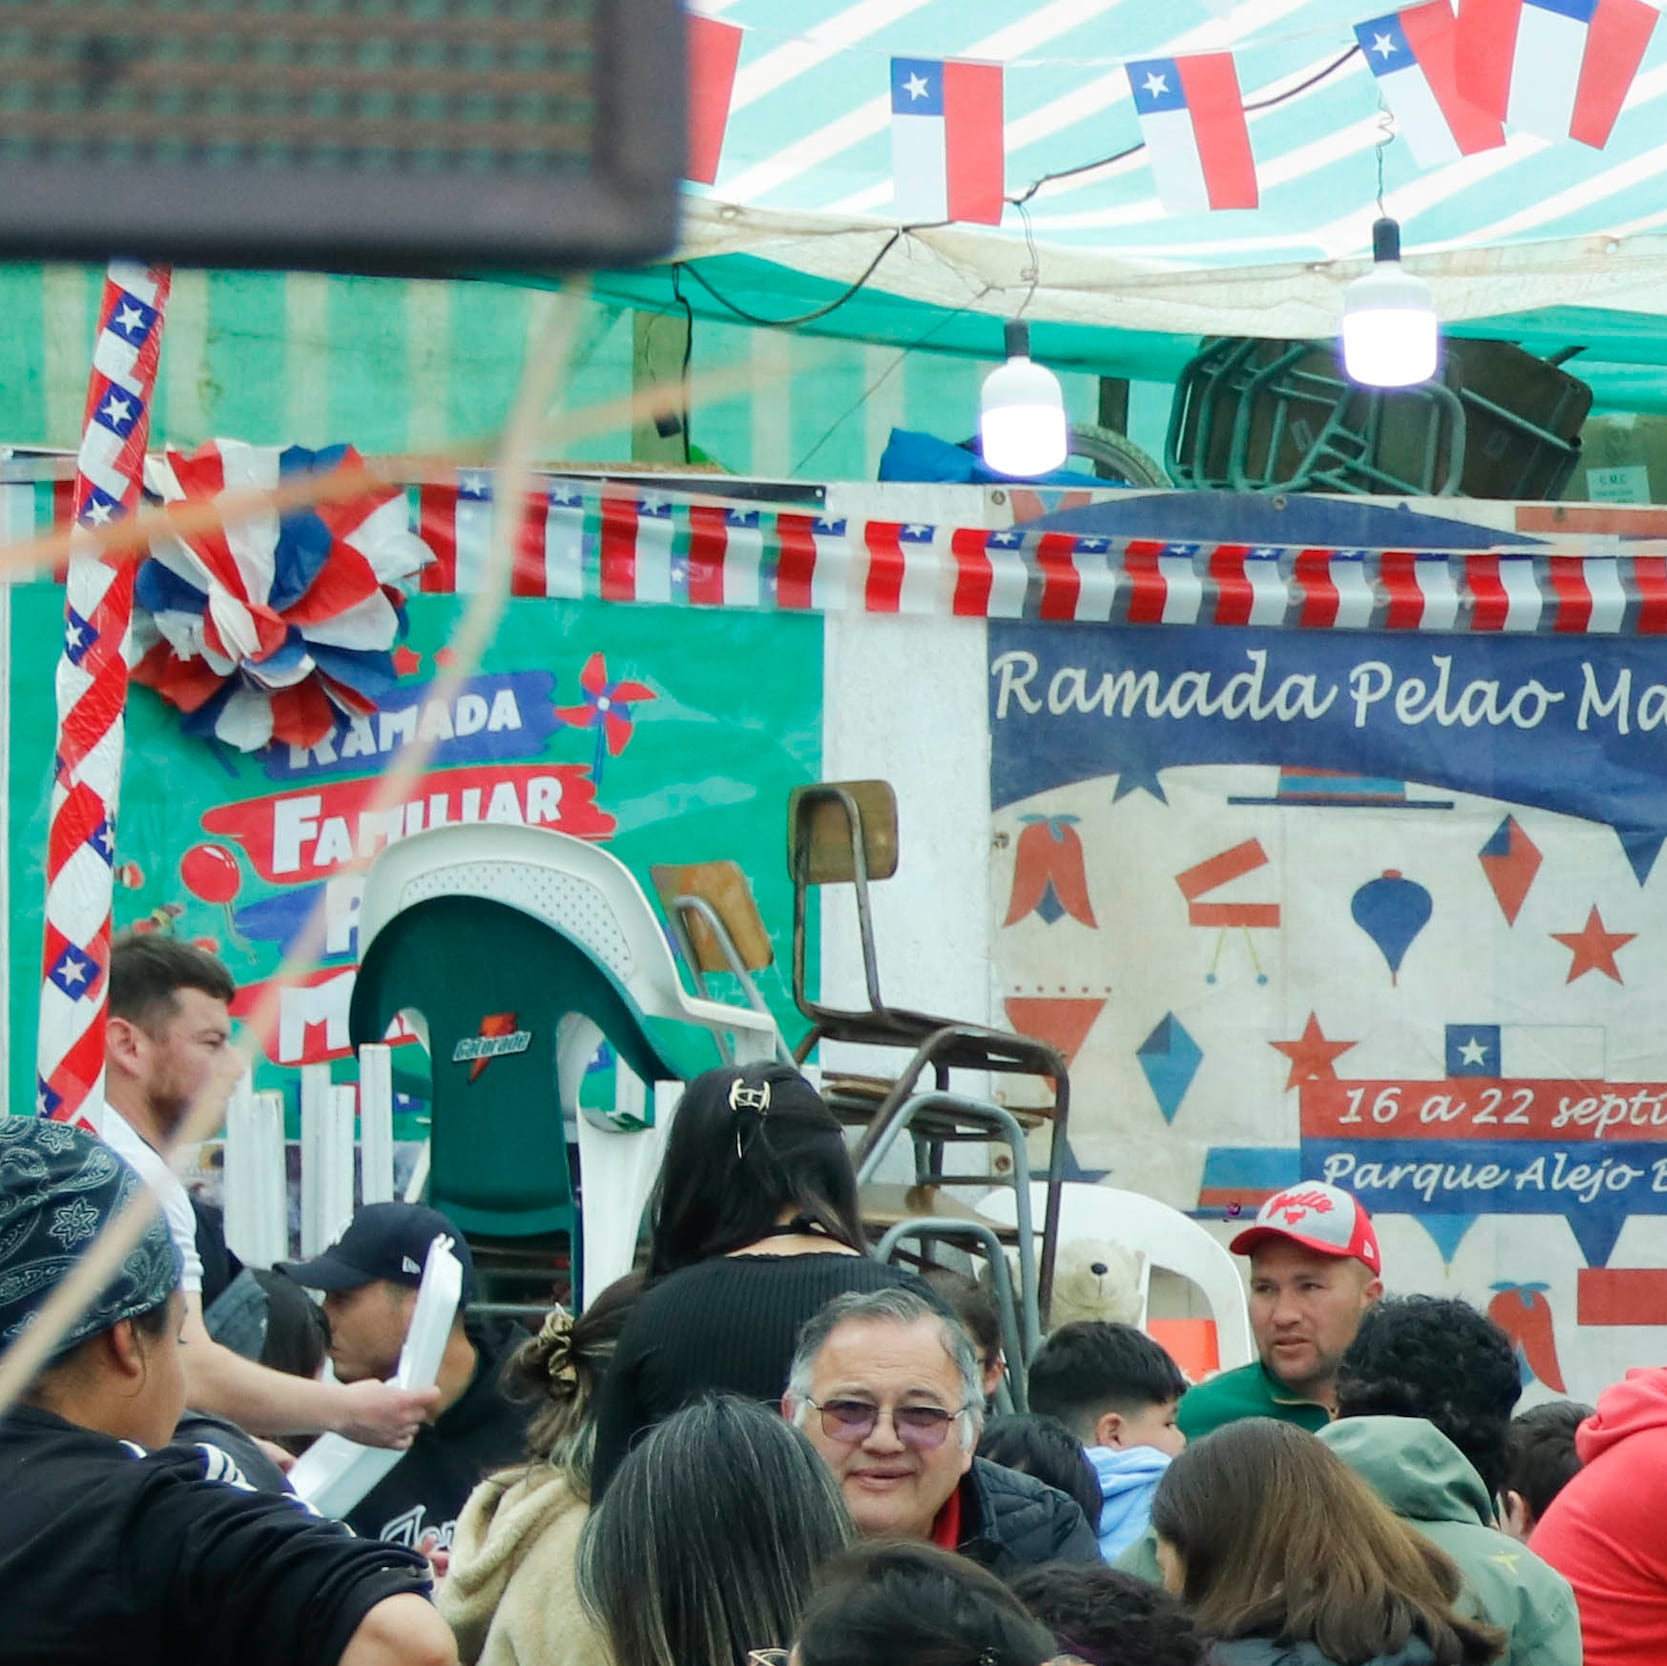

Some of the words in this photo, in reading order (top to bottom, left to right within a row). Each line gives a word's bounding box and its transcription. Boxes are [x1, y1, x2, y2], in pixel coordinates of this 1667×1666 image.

[989, 648, 1338, 722] Ramada
[1349, 655, 1567, 731] Pelao
[289, 689, 522, 770] RAMADA
[1338, 1086, 1403, 1125] 16
[1420, 1097, 1465, 1125] a
[1472, 1087, 1535, 1125] 22
[1323, 1152, 1510, 1202] Parque
[1514, 1152, 1644, 1203] Alejo
